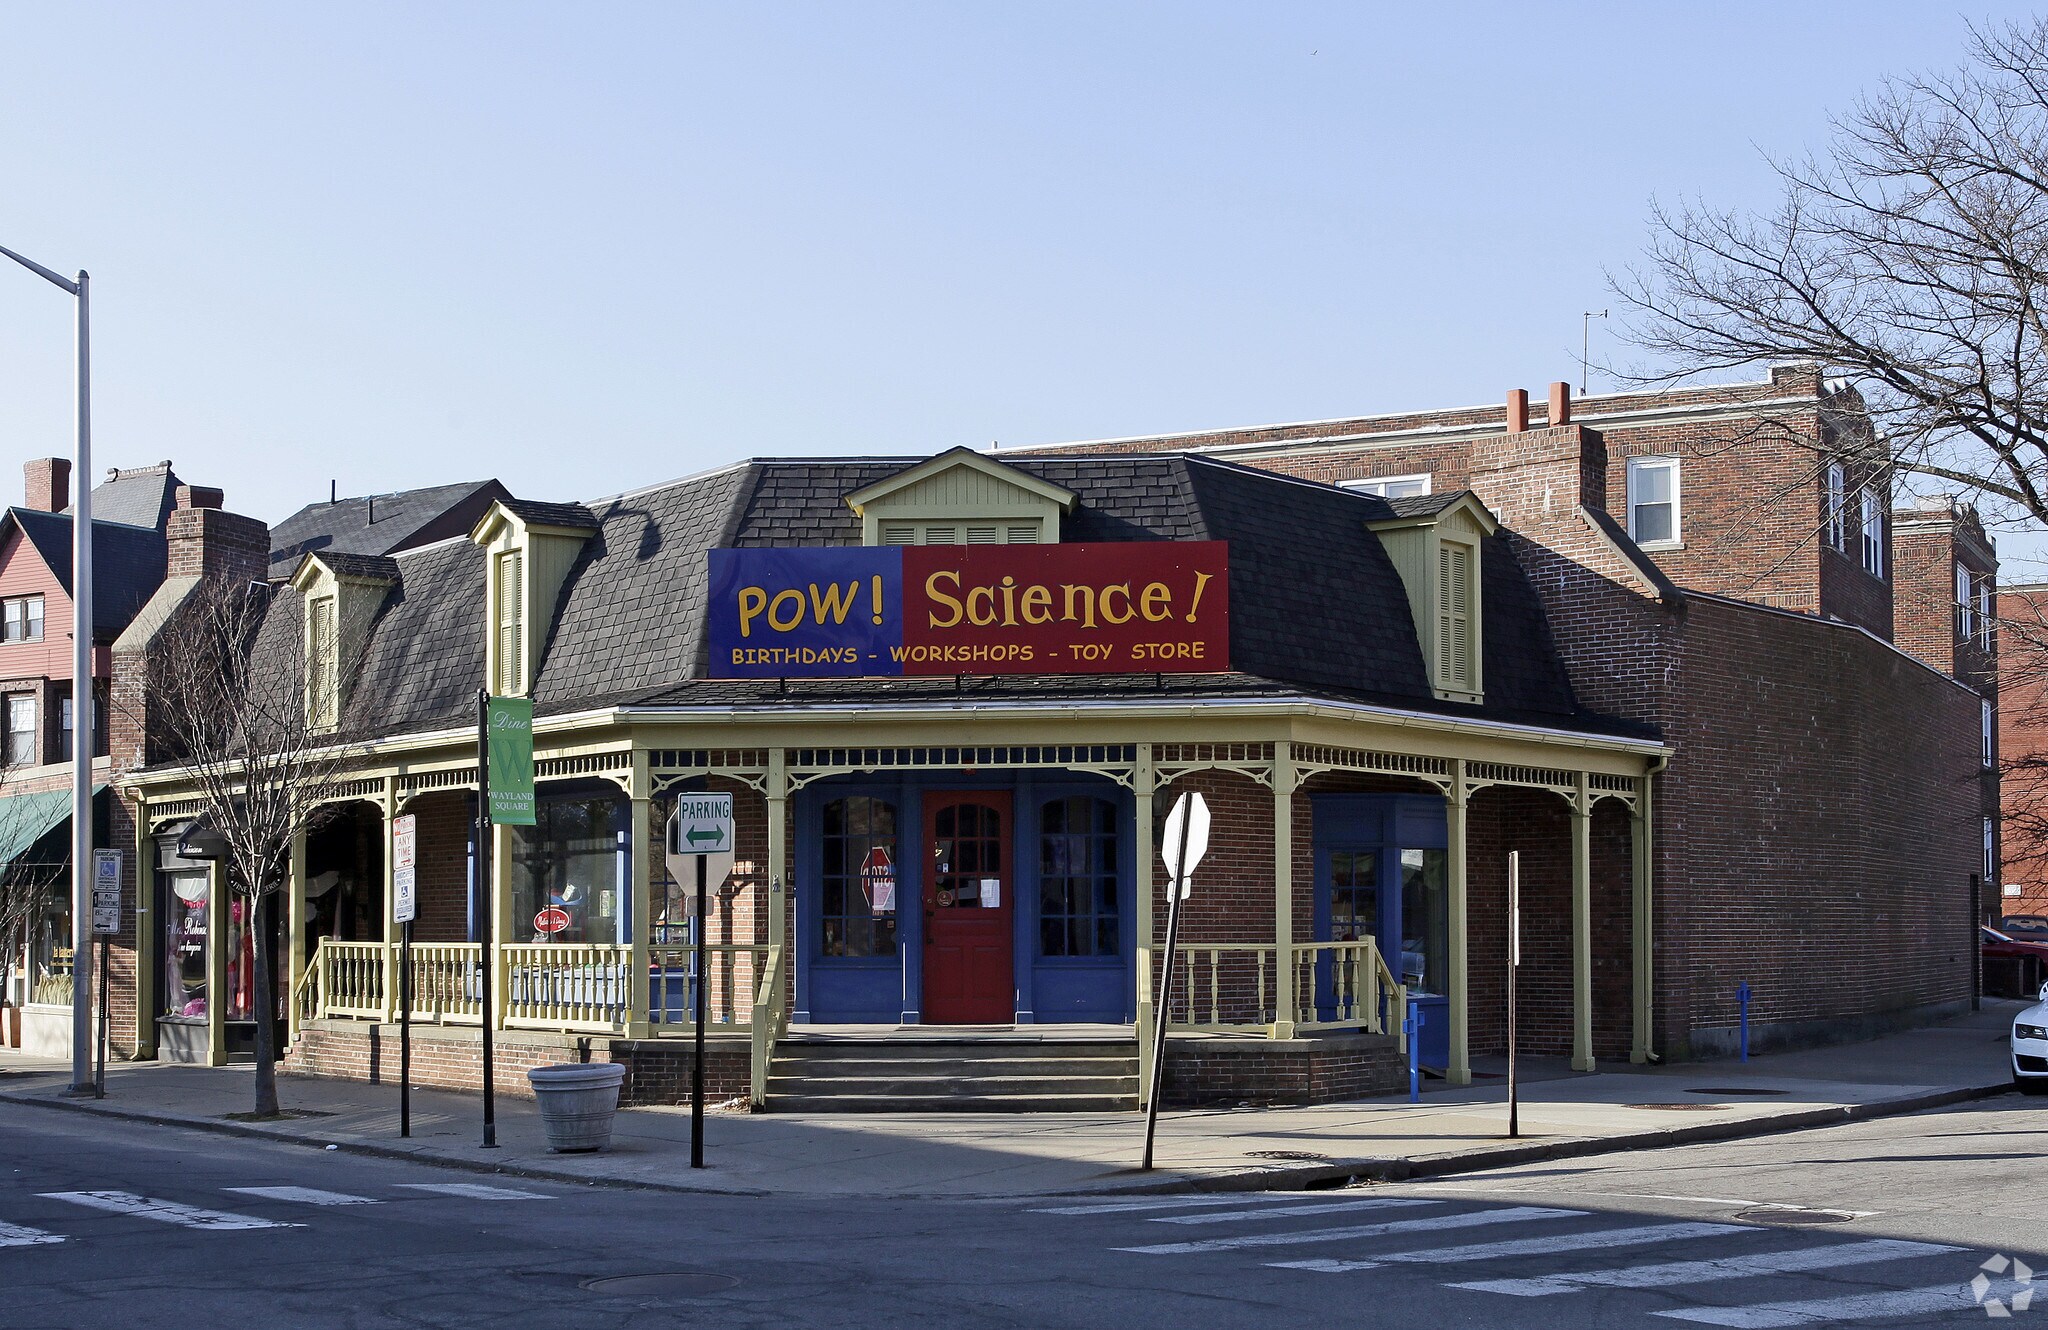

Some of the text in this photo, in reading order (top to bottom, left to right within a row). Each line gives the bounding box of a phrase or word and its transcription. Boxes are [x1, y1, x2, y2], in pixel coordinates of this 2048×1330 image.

[738, 570, 1213, 637] POW! Science!
[732, 647, 857, 665] BIRTHDAYS
[890, 644, 1034, 662] WORKSHOPS
[1069, 643, 1114, 660] TOY
[1131, 641, 1206, 660] STORE
[493, 711, 528, 730] Dine
[490, 740, 532, 786] W
[491, 792, 534, 801] WAYLAND
[495, 802, 529, 811] SQUARE
[682, 800, 730, 820] PARKING
[397, 834, 411, 847] ANY
[397, 846, 411, 858] TIME
